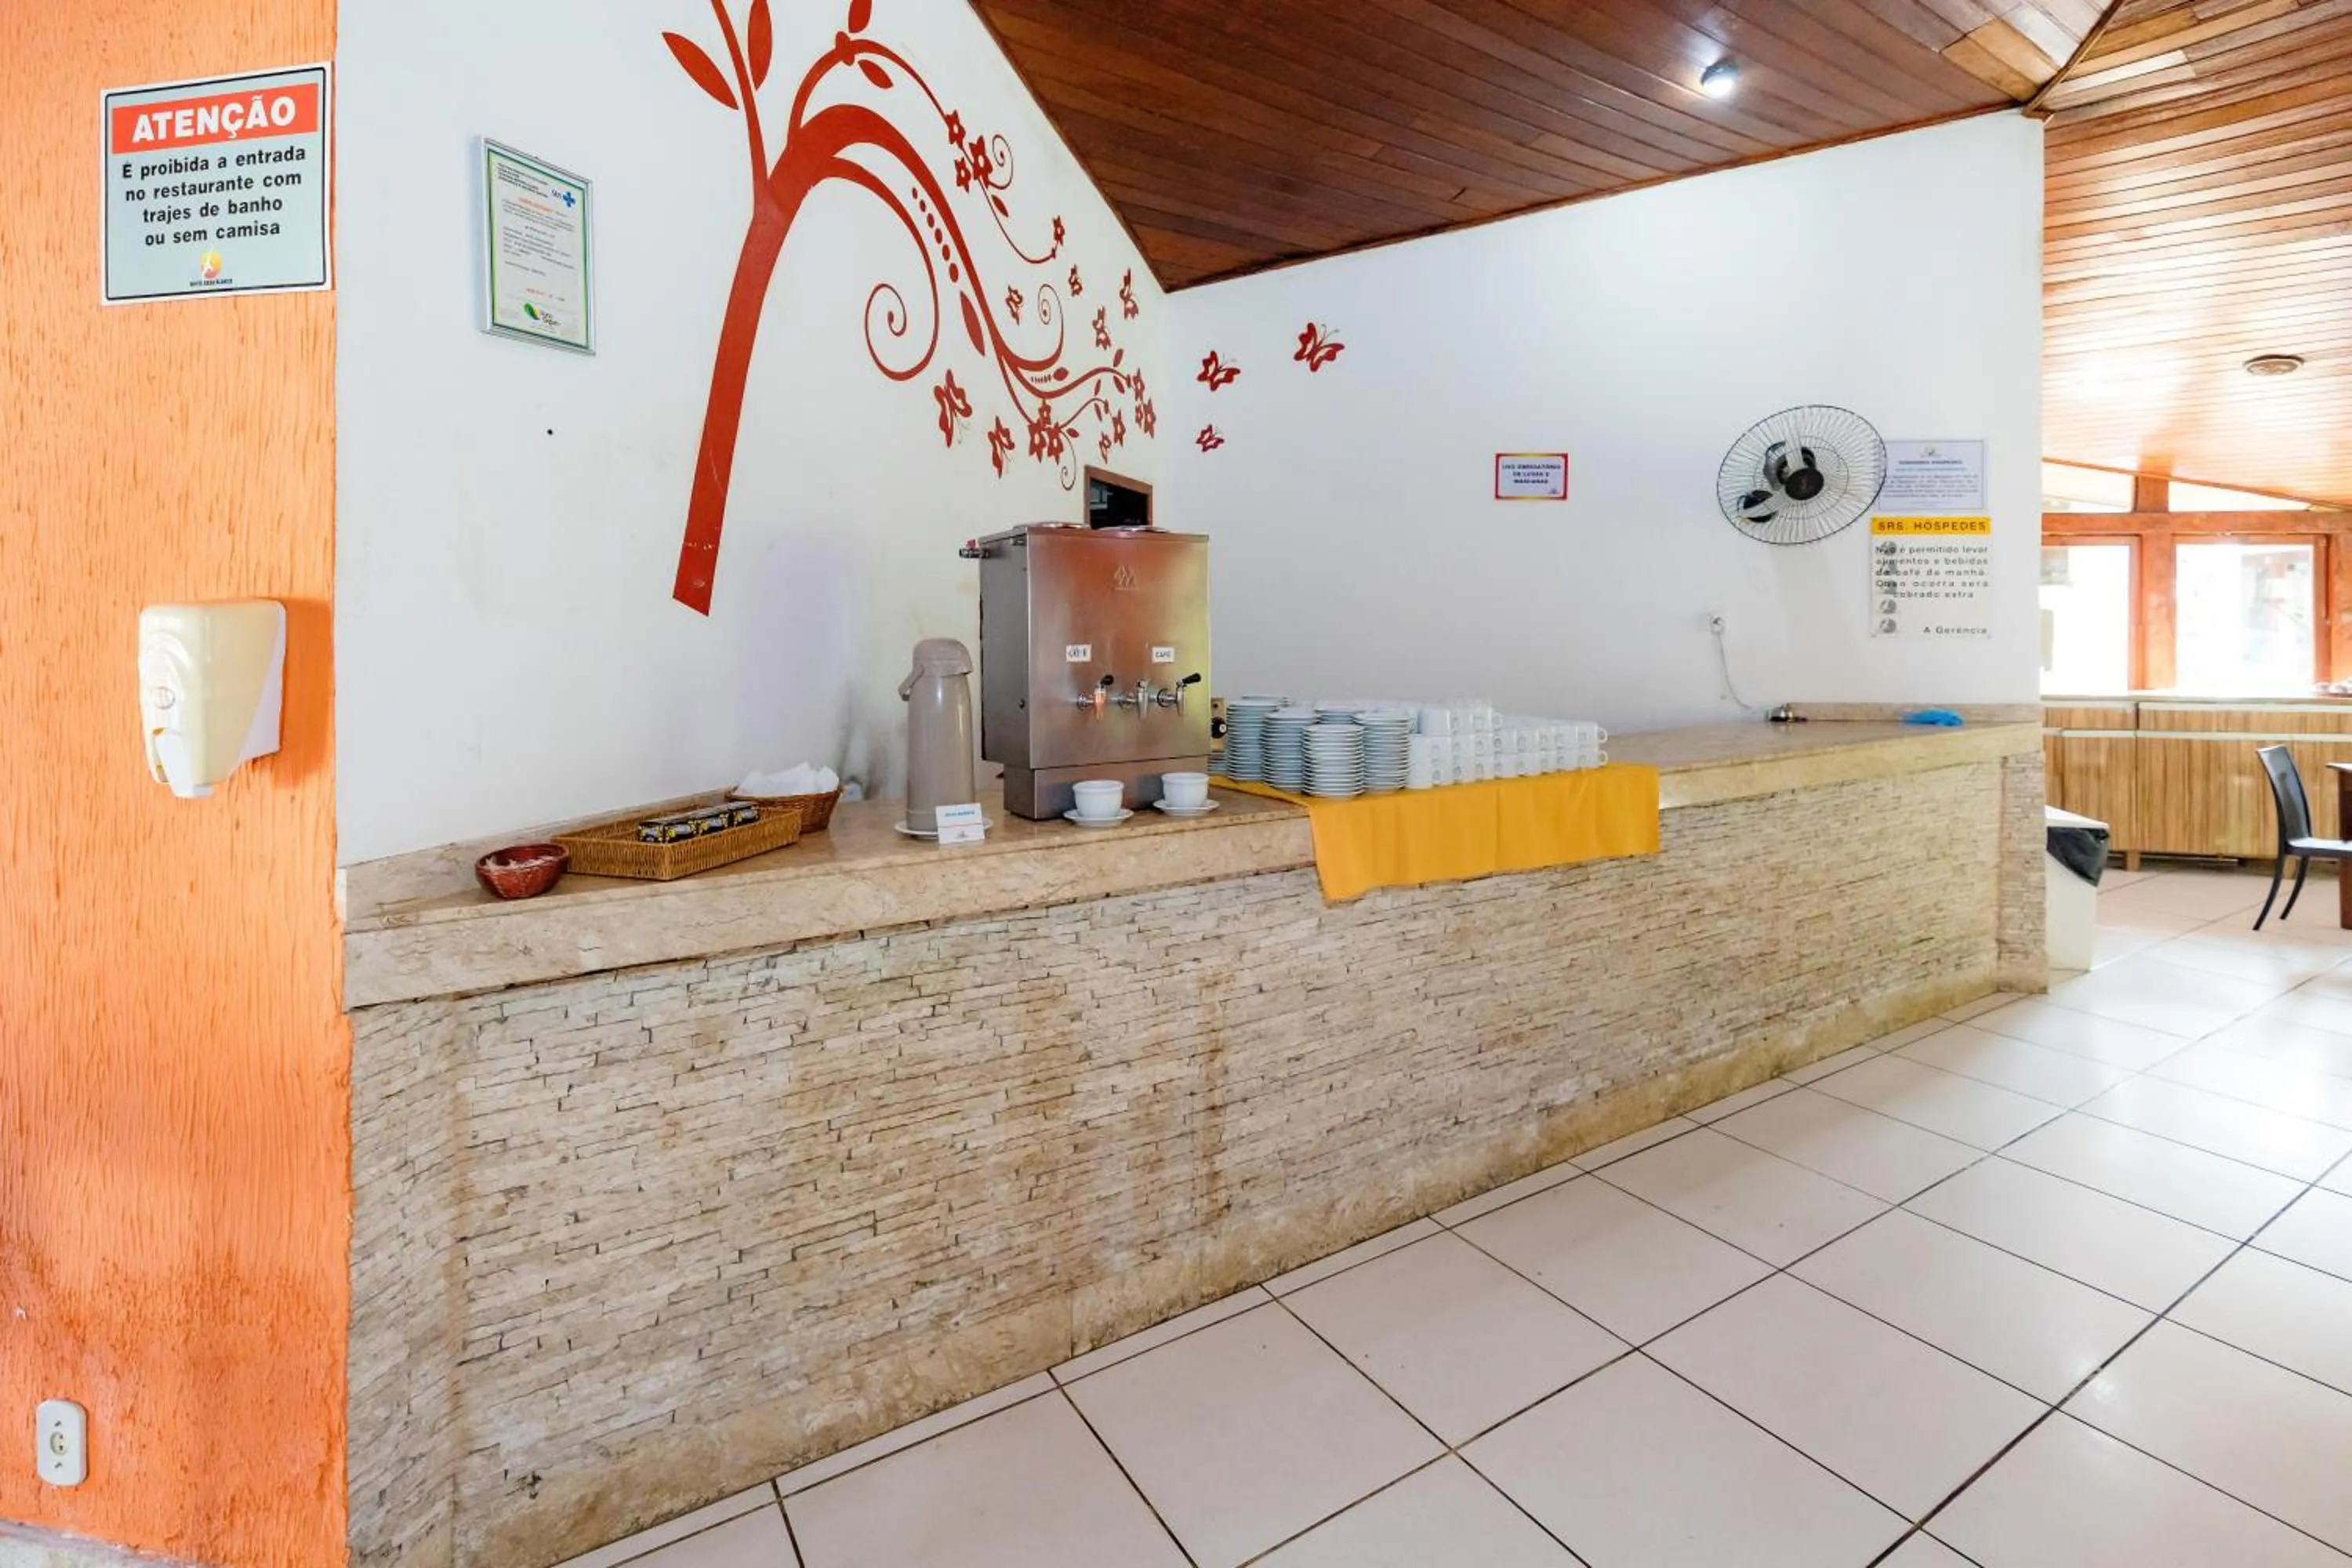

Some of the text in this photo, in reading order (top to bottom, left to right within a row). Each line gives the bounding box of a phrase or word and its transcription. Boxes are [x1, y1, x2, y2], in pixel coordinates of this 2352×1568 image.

[132, 94, 296, 143] ATENÇÃO
[122, 145, 307, 181] É proibida a entrada
[125, 171, 302, 201] no restaurante com
[143, 197, 283, 224] trajes de banho
[145, 220, 281, 246] ou sem camisa
[1909, 546, 1959, 554] permitido
